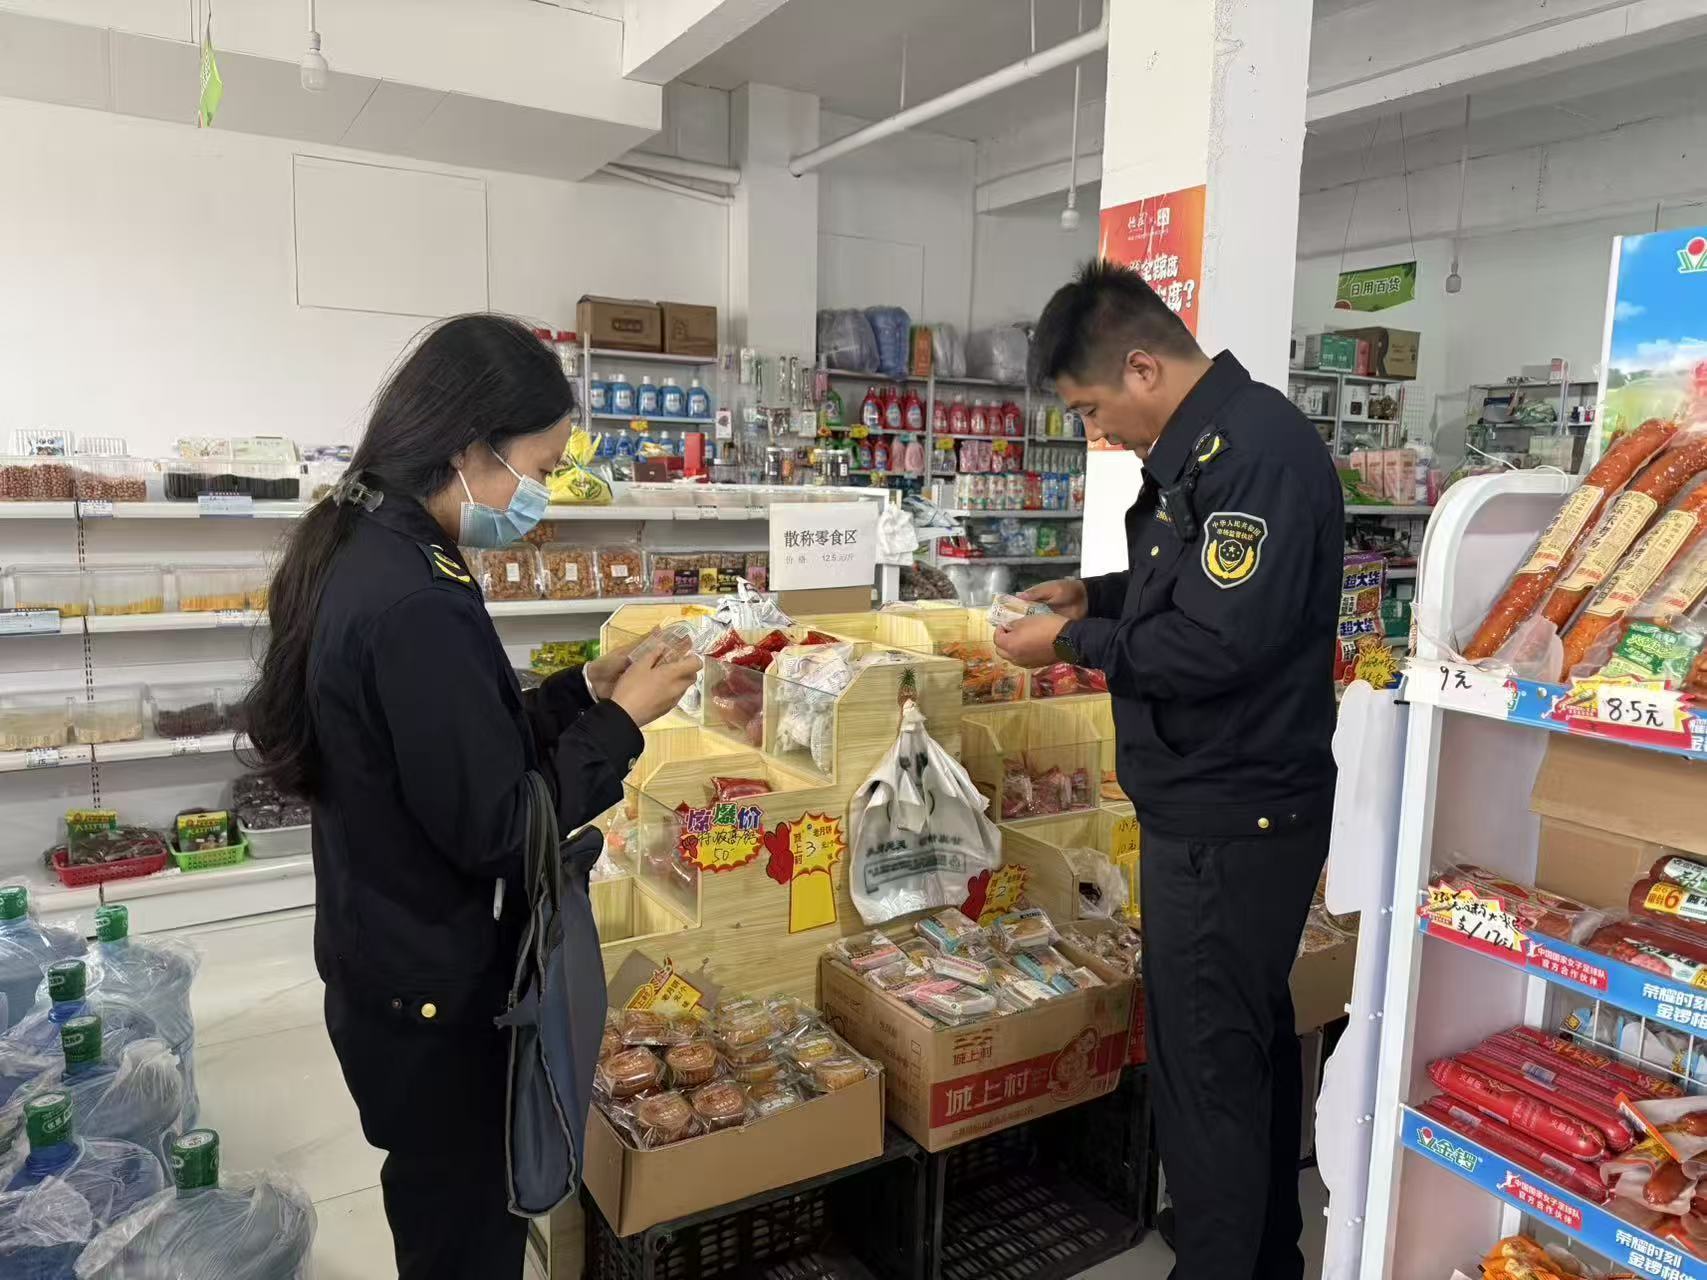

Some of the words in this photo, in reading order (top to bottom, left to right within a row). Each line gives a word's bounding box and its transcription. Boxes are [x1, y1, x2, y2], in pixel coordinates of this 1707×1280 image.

[1350, 276, 1401, 297] 日用百货
[784, 529, 857, 548] 散称零食区
[1212, 519, 1261, 537] 中华人民共和国
[1439, 666, 1473, 691] 9元
[1606, 697, 1664, 728] 8.5元
[805, 841, 817, 858] 3
[996, 885, 1007, 898] 2
[1537, 947, 1606, 980] 中国国家女子足球队
[1542, 958, 1598, 988] 官方合作伙伴
[1642, 983, 1707, 1012] 荣耀时刻
[1436, 1138, 1477, 1172] 金锣
[1514, 1178, 1581, 1220] 中国国家女子足球队
[1518, 1190, 1573, 1225] 官方合作伙伴
[1615, 1229, 1683, 1268] 荣耀时刻
